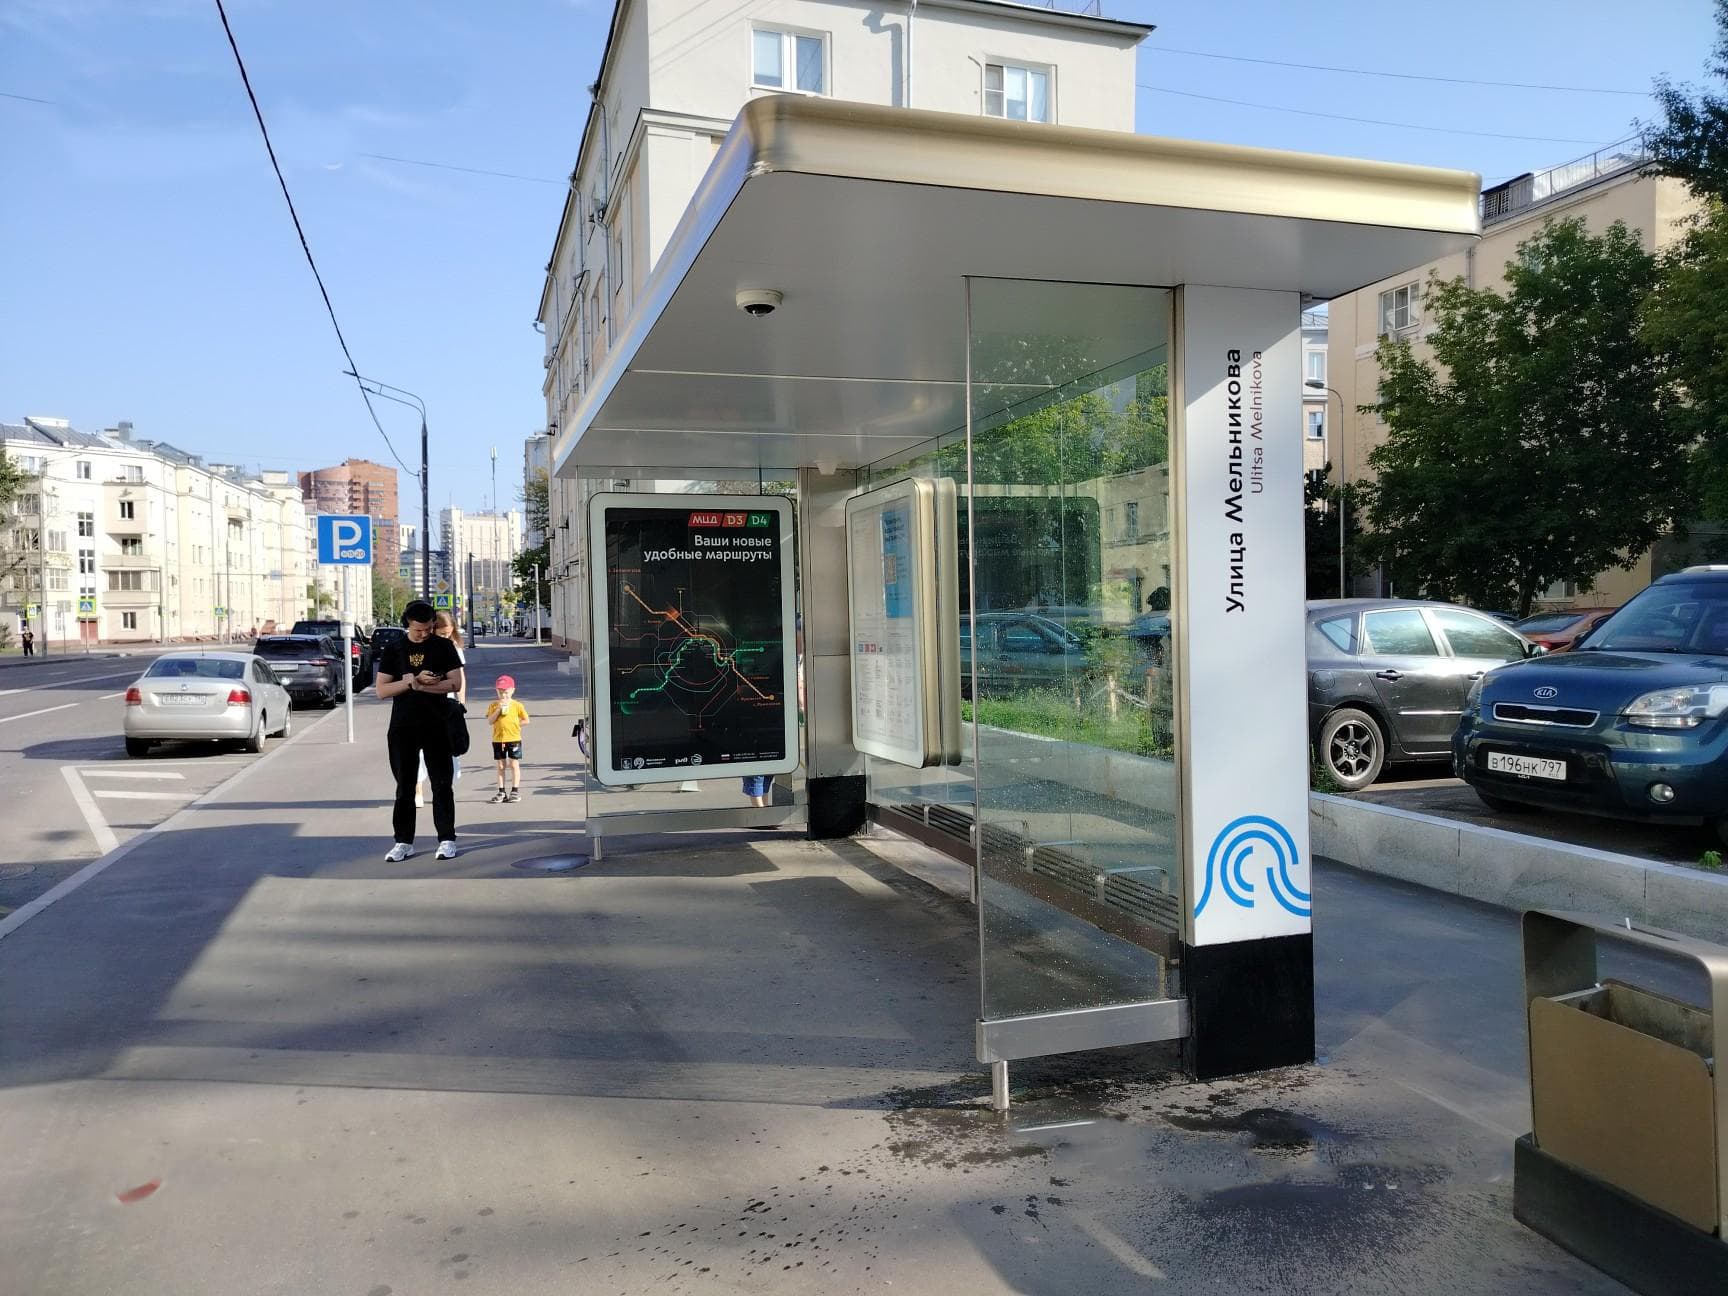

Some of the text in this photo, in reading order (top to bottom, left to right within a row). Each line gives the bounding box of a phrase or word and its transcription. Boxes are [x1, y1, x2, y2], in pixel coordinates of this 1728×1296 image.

[1250, 351, 1264, 494] Ulitsa Melnikova
[1225, 349, 1247, 612] Улица Мельникова
[692, 515, 767, 525] МЦД D3 D4
[332, 520, 362, 560] P
[694, 535, 772, 547] Ваши новые
[643, 548, 772, 562] удобные маршруты
[1536, 688, 1554, 697] KIA
[1491, 756, 1562, 775] В196НК 797
